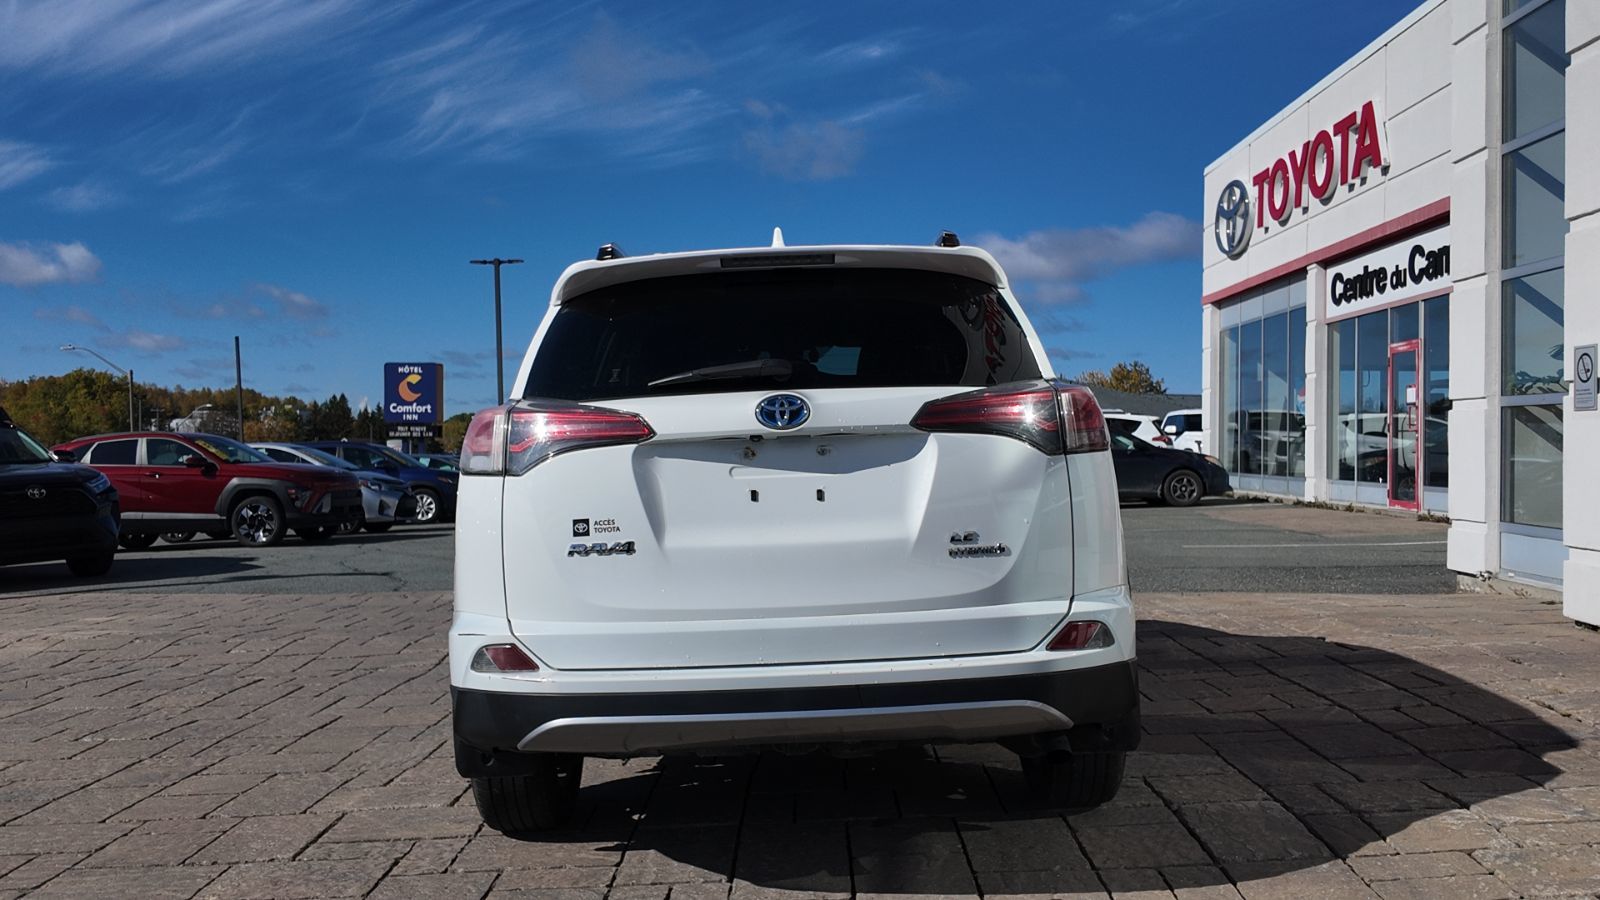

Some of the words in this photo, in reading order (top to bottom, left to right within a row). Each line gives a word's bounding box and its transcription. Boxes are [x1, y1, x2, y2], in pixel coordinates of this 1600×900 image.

[1252, 100, 1382, 229] TOYOTA
[1330, 265, 1388, 307] Centre
[1390, 265, 1408, 290] du
[398, 365, 423, 374] HÔTEL
[389, 403, 432, 413] Comfort
[593, 518, 615, 526] ACCÈS
[567, 541, 636, 557] RAV4
